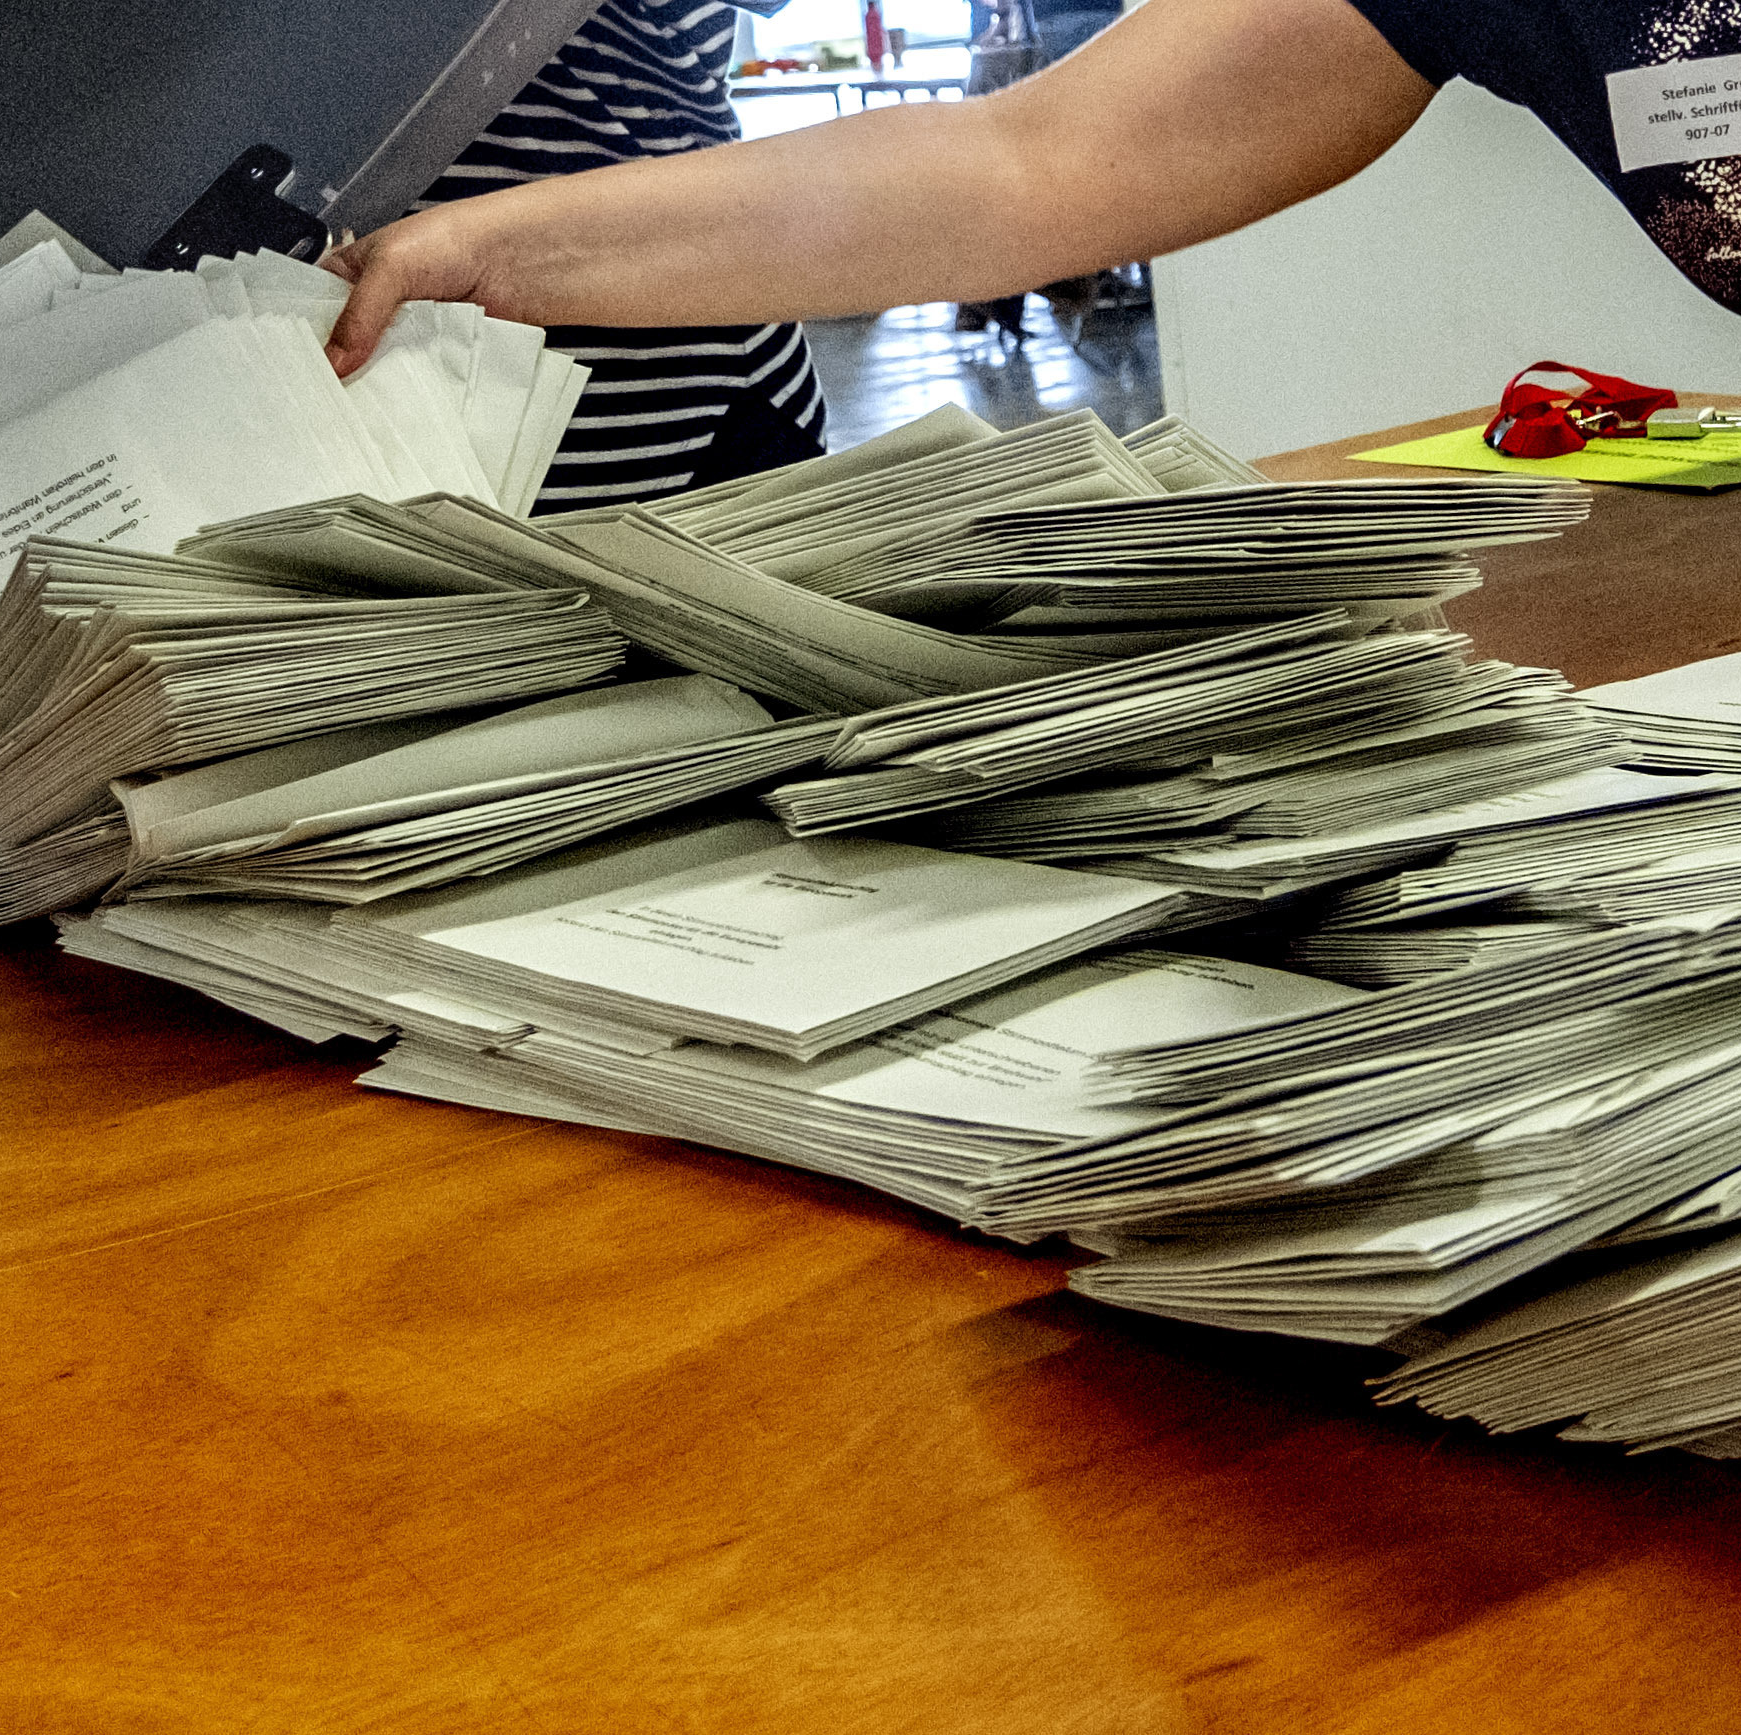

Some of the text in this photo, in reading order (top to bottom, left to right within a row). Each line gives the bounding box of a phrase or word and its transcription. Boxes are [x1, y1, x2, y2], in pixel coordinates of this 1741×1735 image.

[1661, 83, 1717, 101] Stefanie
[1647, 109, 1688, 125] stellv.
[1684, 123, 1731, 141] 907-07
[85, 458, 106, 474] den
[121, 497, 142, 514] und
[45, 500, 103, 535] Wahlschein
[1, 519, 32, 538] Eides
[105, 517, 139, 541] diesen
